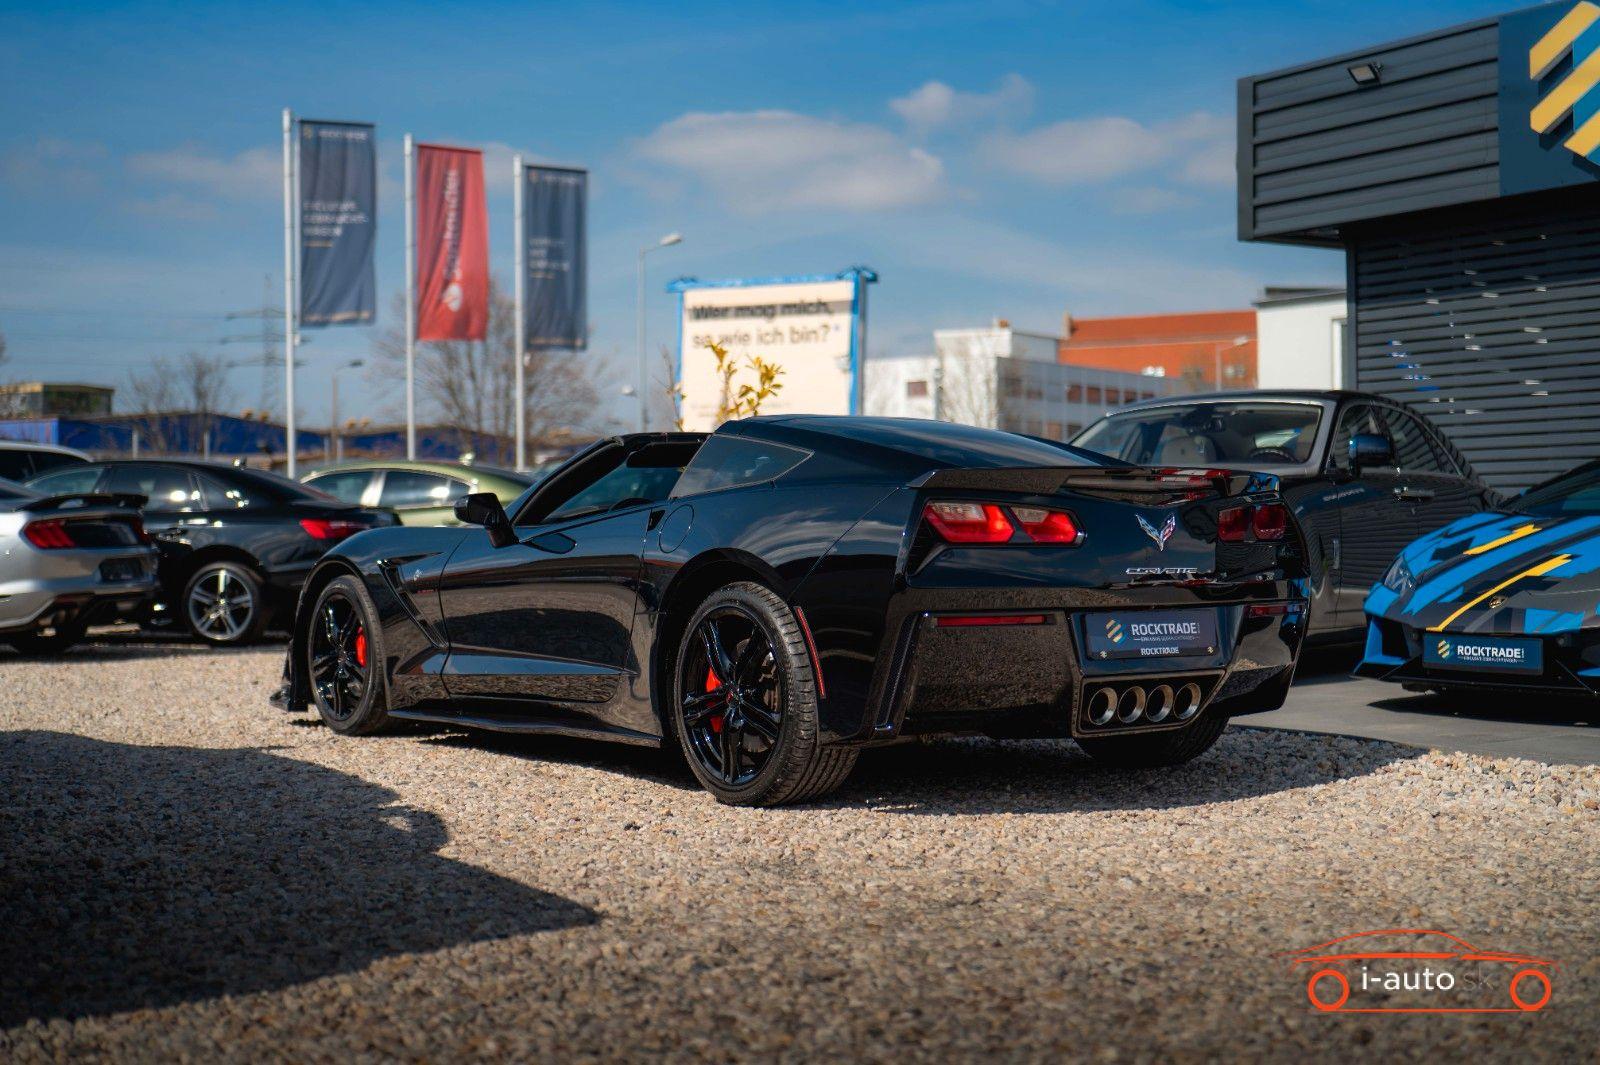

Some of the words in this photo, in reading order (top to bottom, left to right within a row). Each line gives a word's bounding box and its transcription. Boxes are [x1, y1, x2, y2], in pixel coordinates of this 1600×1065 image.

[692, 306, 729, 320] Wer
[734, 304, 776, 322] mag
[719, 330, 750, 346] wie
[756, 327, 785, 345] ich
[789, 324, 831, 344] bin?
[1131, 622, 1197, 635] ROCKTRADE
[1140, 646, 1179, 655] ROCKTRADE
[1457, 645, 1521, 658] ROCKTRADE
